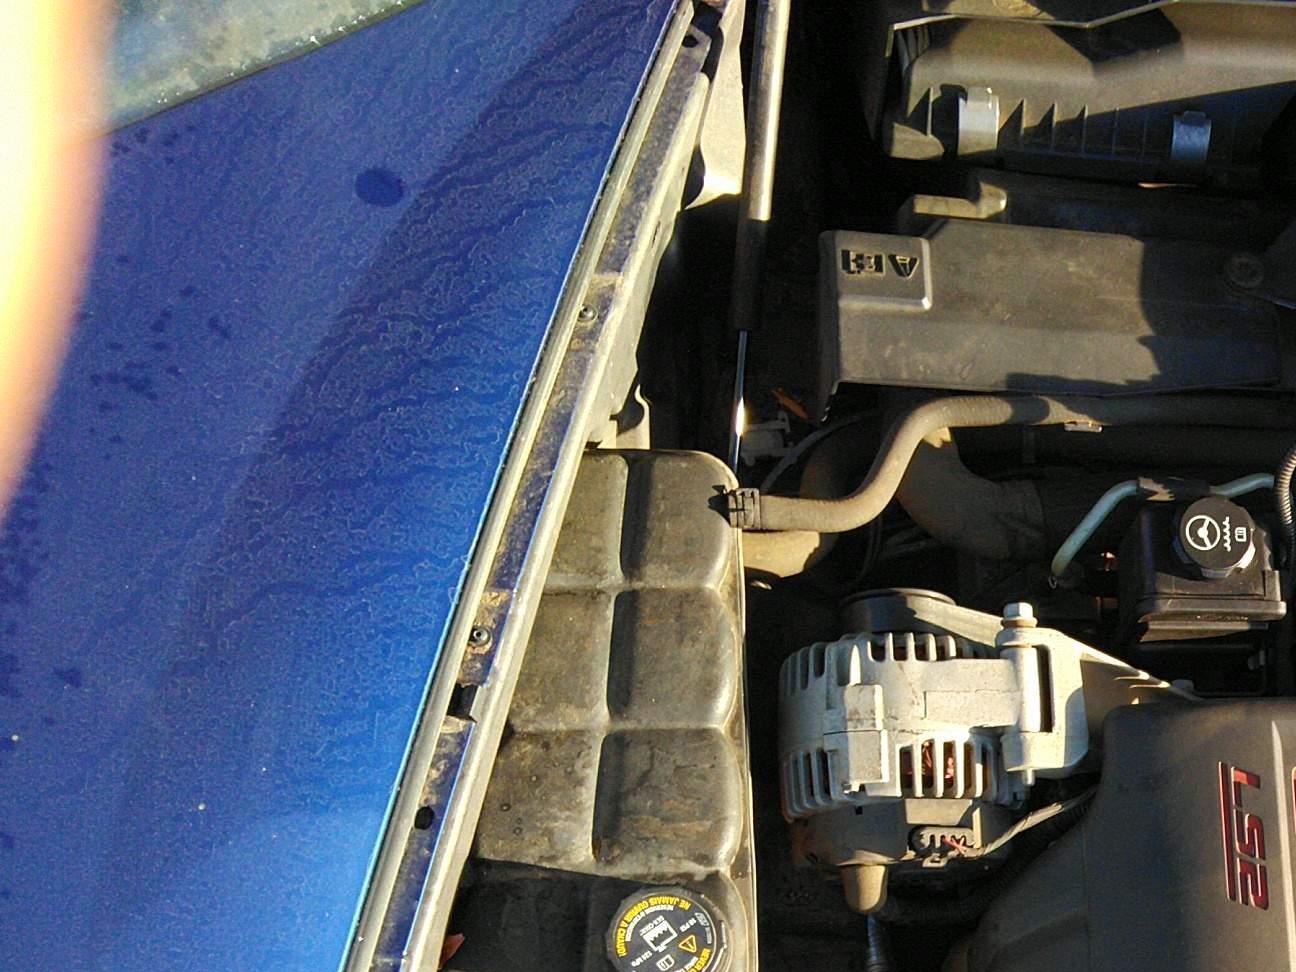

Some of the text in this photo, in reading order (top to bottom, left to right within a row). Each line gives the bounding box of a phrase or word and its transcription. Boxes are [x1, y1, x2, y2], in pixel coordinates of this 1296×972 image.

[1229, 766, 1270, 911] LS2
[624, 900, 649, 924] OUVRIR
[649, 896, 680, 906] JAMAIS
[616, 927, 628, 957] CHAUD!
[695, 948, 711, 969] NEVER
